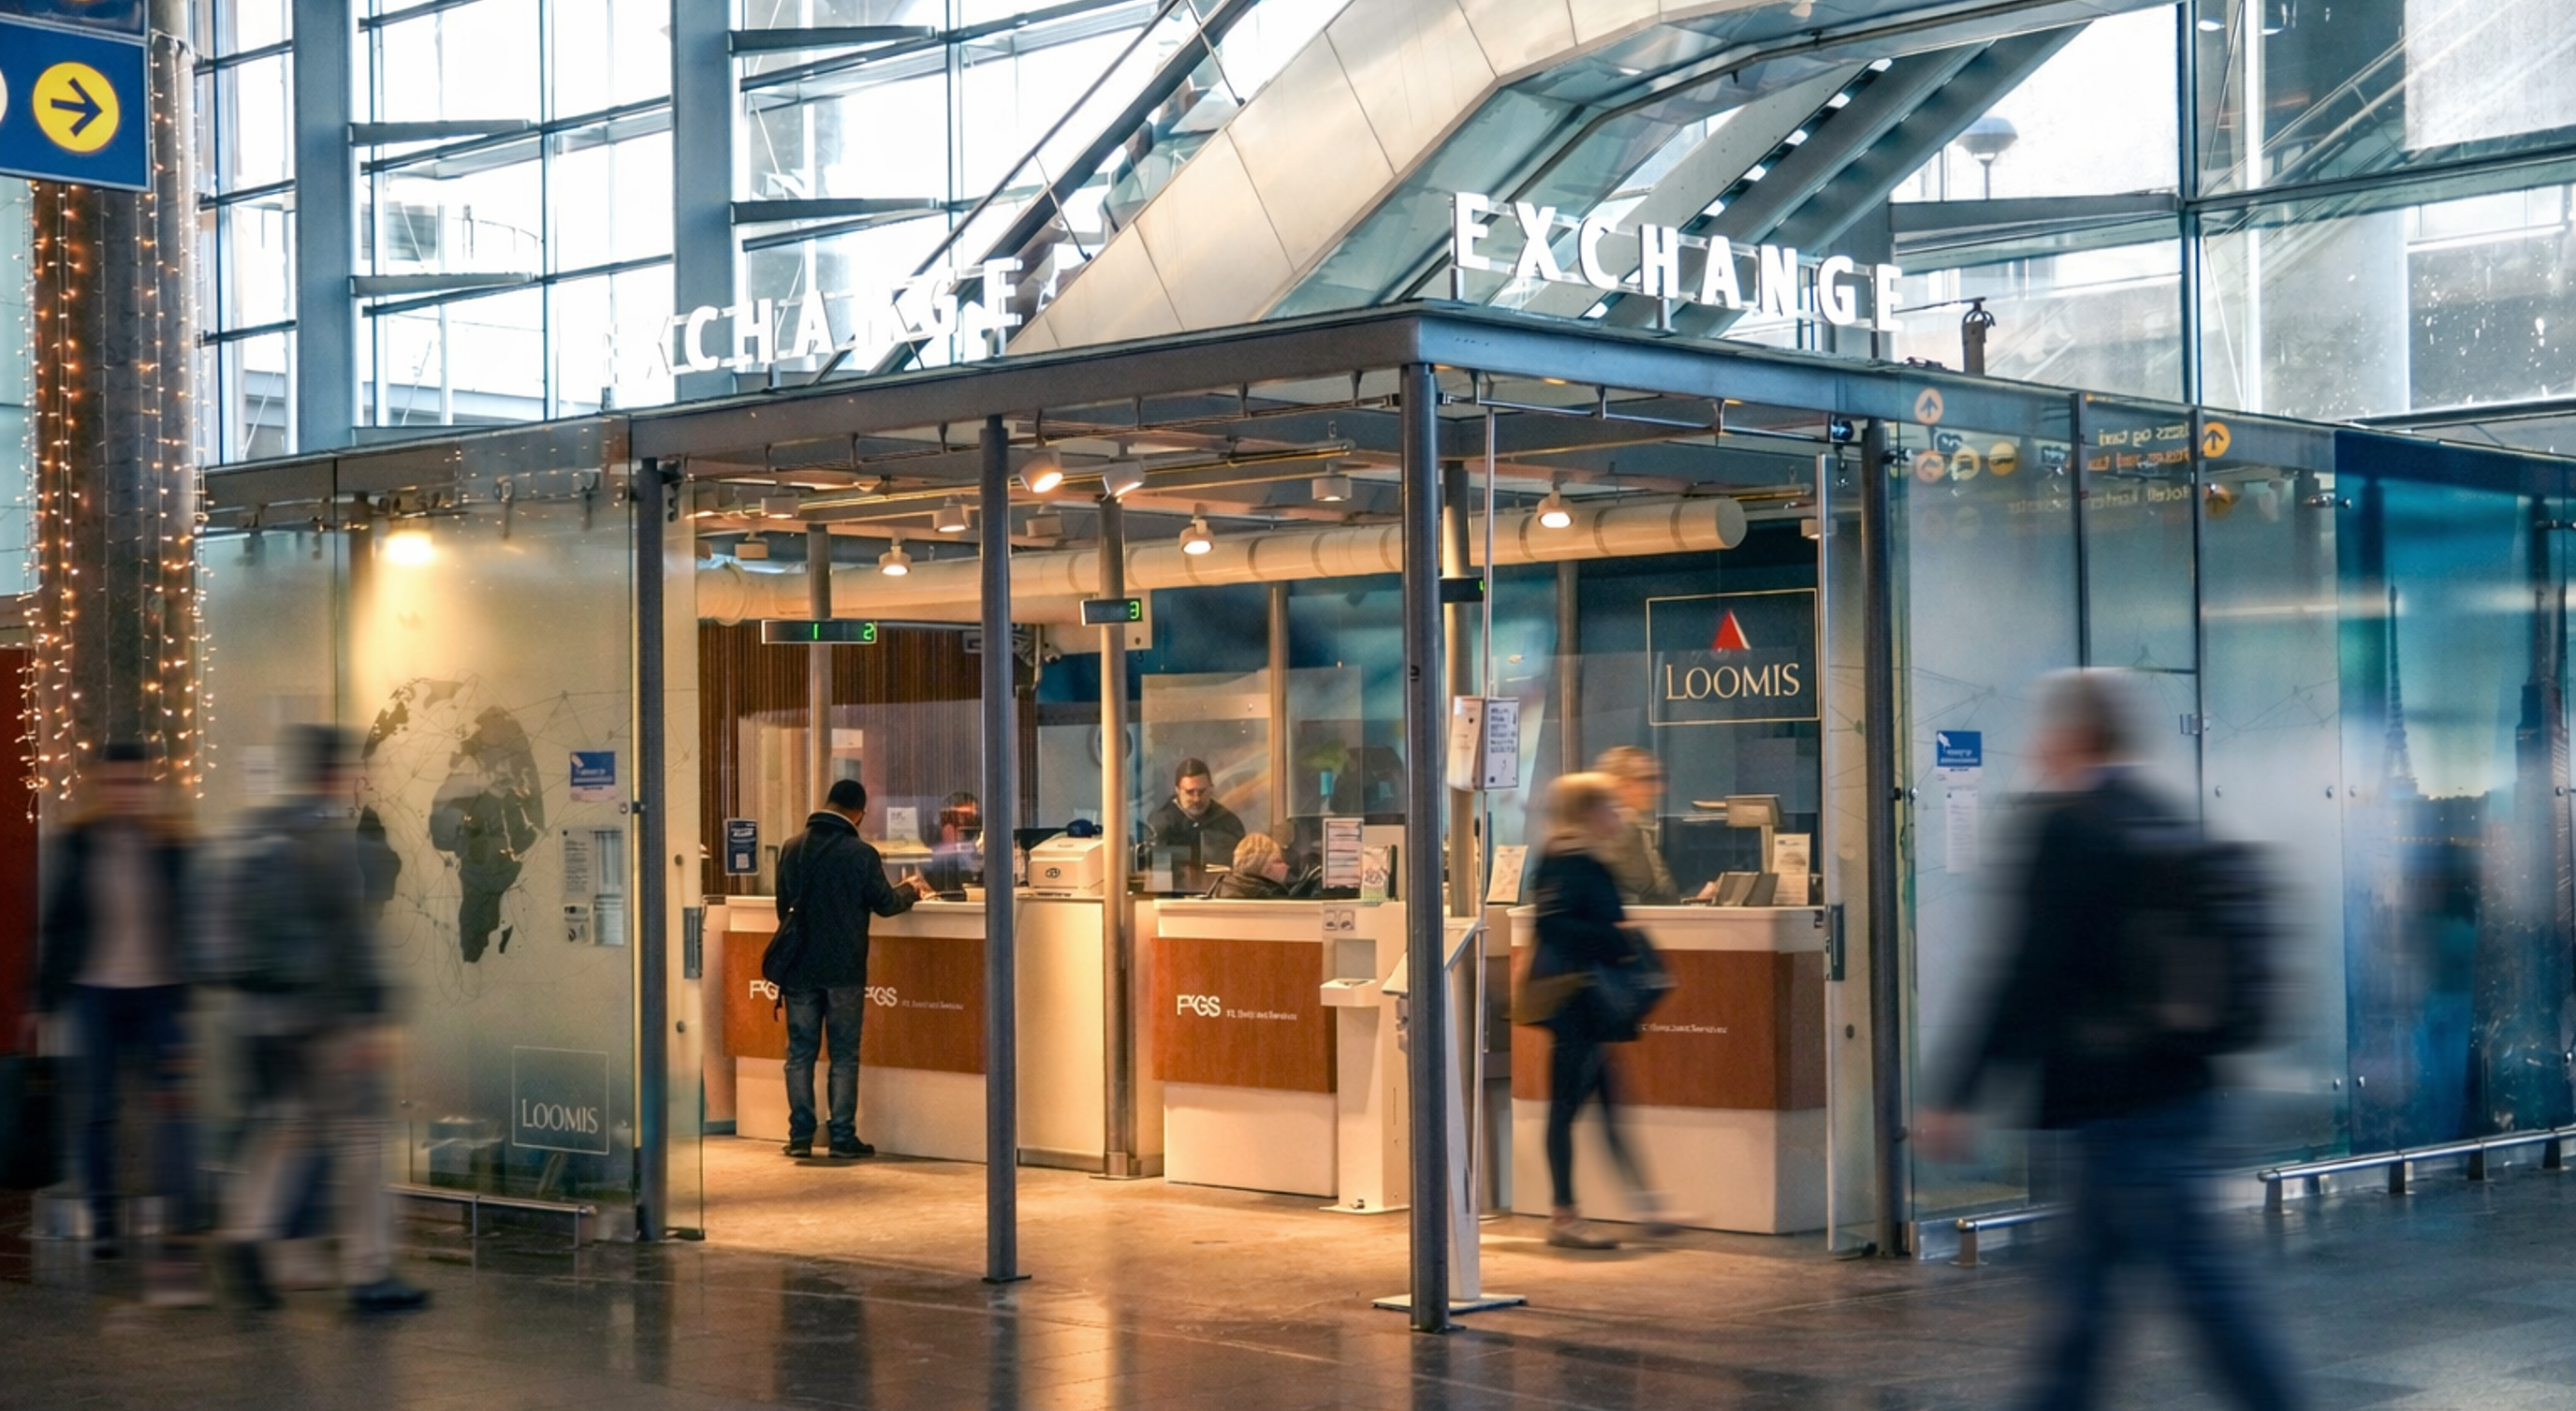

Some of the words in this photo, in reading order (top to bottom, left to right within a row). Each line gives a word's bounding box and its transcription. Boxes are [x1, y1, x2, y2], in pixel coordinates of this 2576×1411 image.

[1453, 192, 1903, 331] EXCHANGE
[1130, 601, 1139, 619] 3
[813, 623, 818, 640] 1
[863, 623, 874, 640] 2
[1665, 662, 1801, 700] LOOMIS
[521, 1098, 599, 1135] LOOMIS
